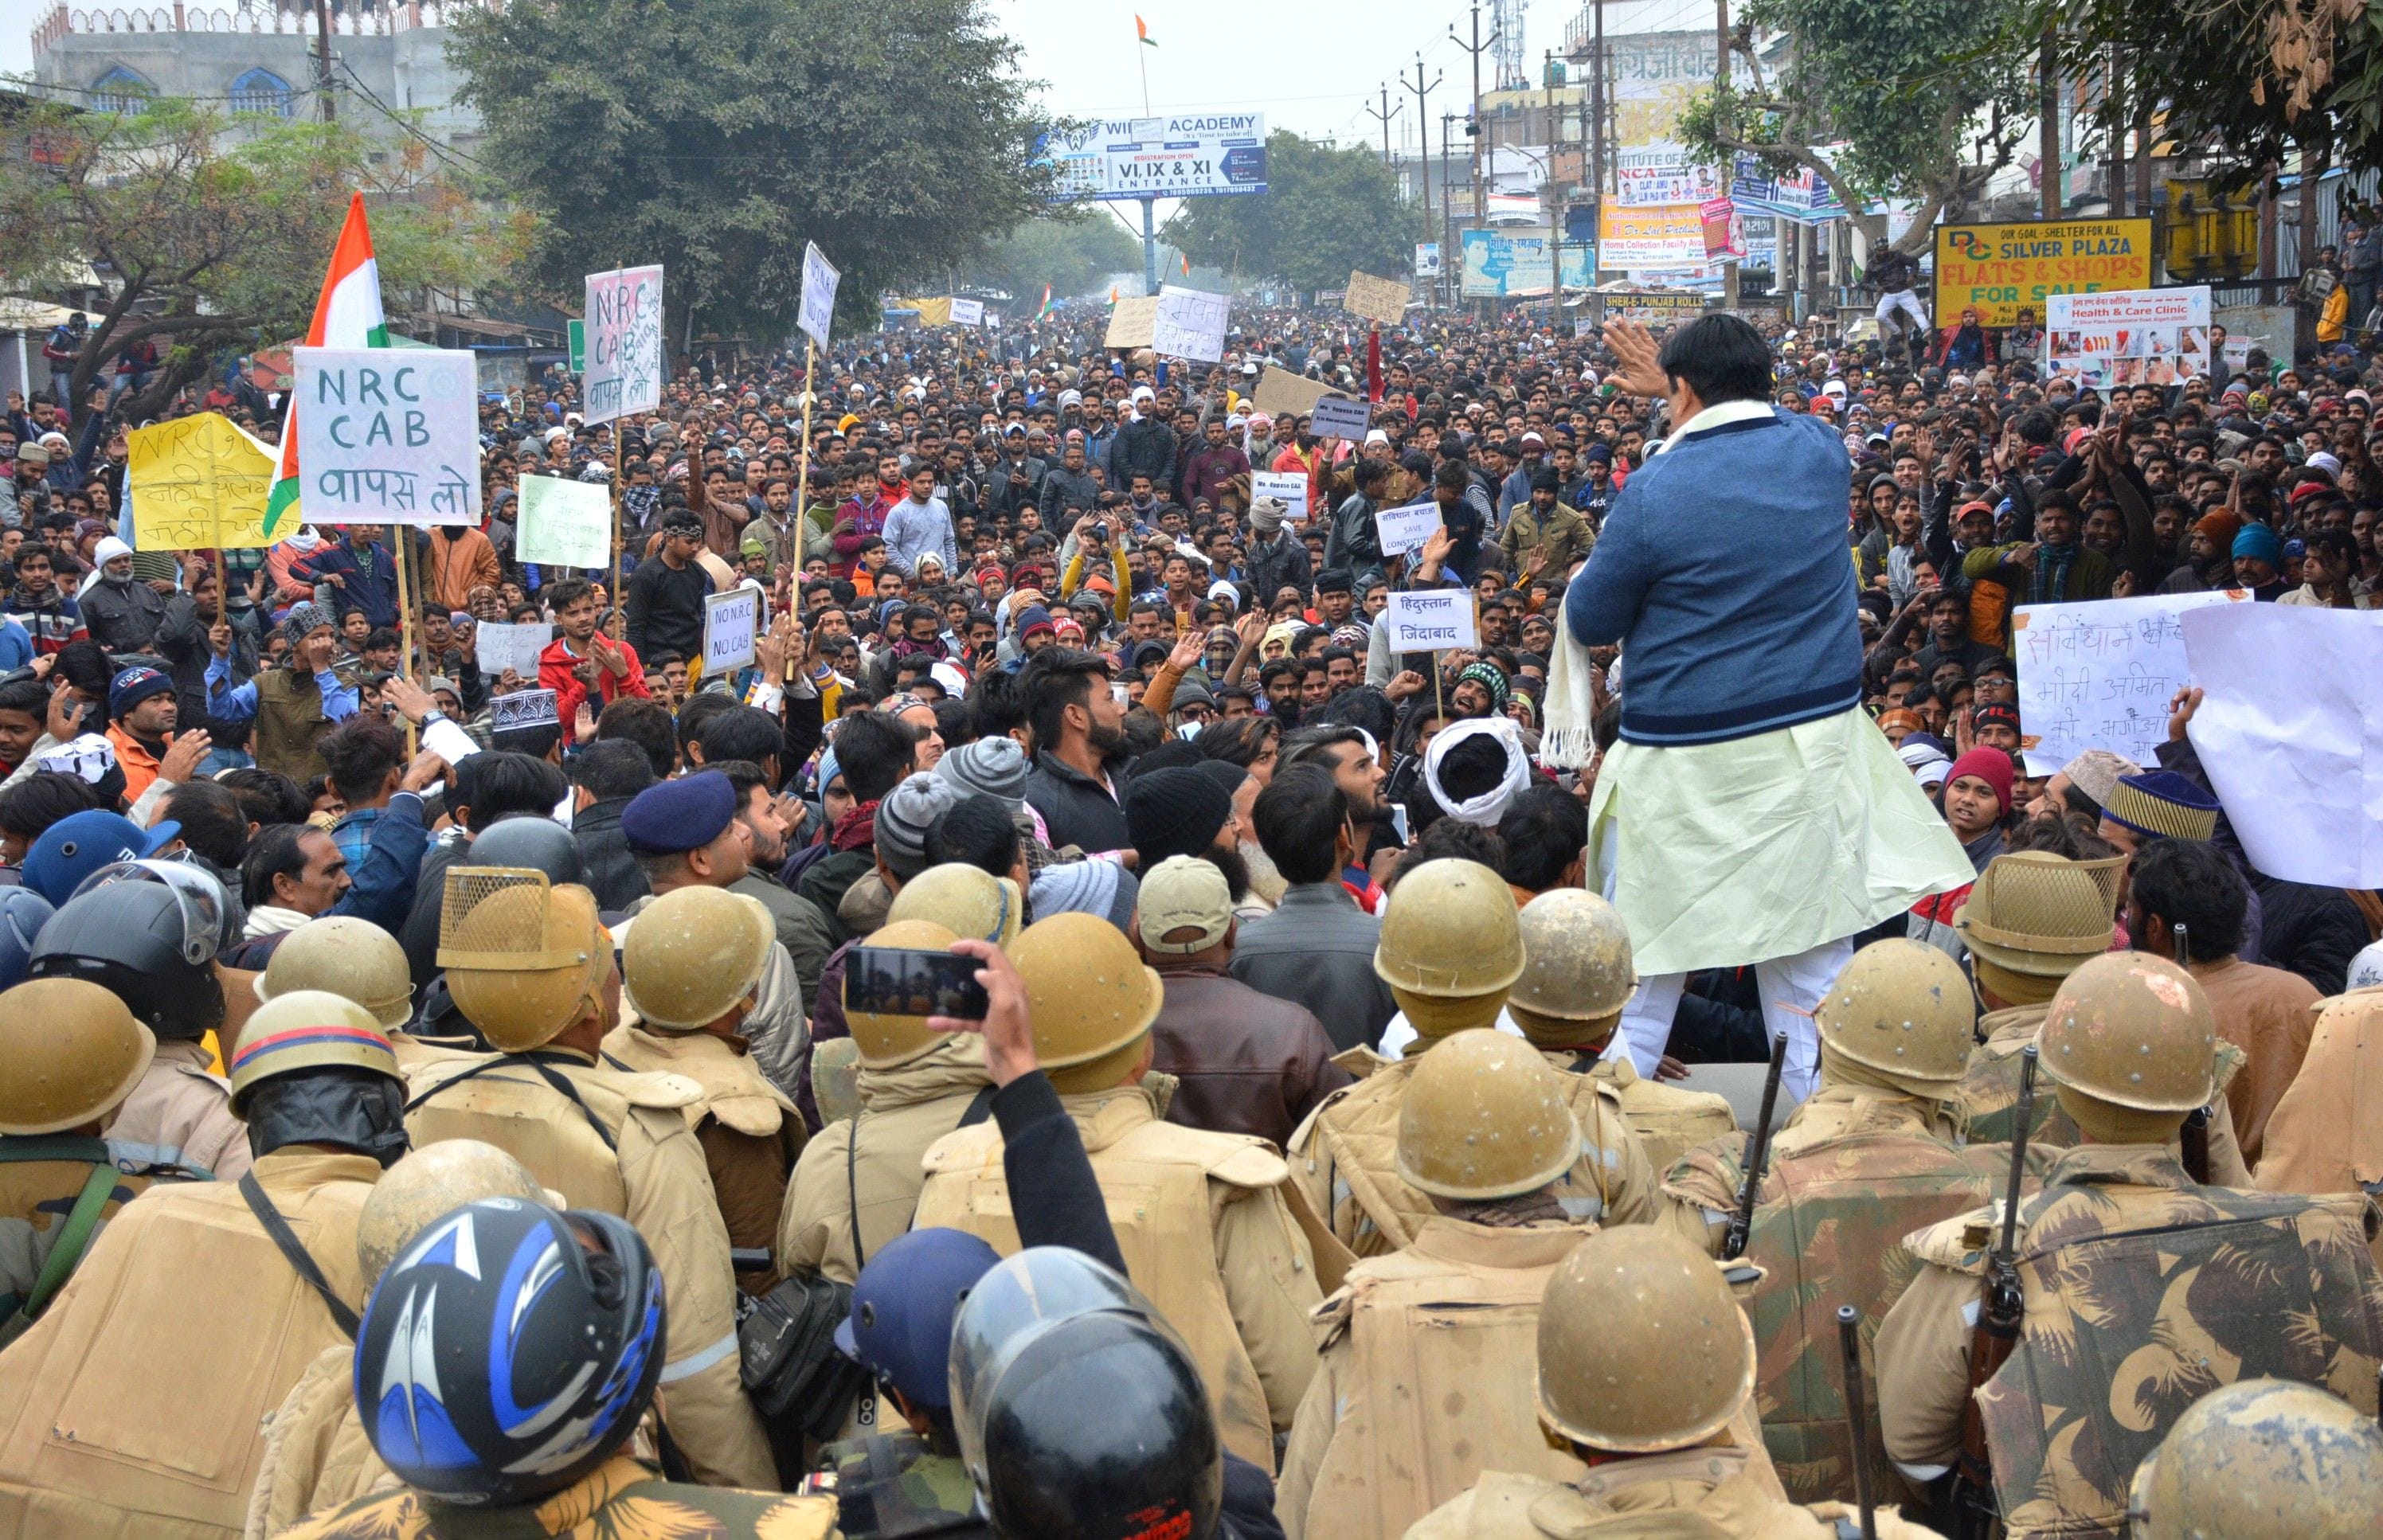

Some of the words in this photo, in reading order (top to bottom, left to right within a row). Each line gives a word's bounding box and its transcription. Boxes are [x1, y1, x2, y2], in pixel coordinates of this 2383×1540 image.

[1169, 116, 1255, 132] ACADEMY
[1119, 163, 1142, 179] VI,
[1147, 162, 1165, 177] IX
[1173, 161, 1184, 175] &
[1192, 160, 1211, 175] XI
[1618, 167, 1657, 180] NCA
[1119, 176, 1212, 188] ENTRANCE
[1665, 223, 1704, 234] PathLa
[2001, 229, 2015, 240] OUR
[2018, 228, 2038, 240] GOAL
[2045, 226, 2084, 239] SHELTER
[2086, 225, 2103, 236] FOR
[2105, 225, 2120, 236] ALL
[1604, 240, 1624, 249] Home
[1626, 240, 1660, 249] Collection
[1662, 240, 1687, 249] Facility
[2000, 241, 2063, 260] SILVER
[2072, 237, 2132, 256] PLAZA
[1941, 261, 2027, 286] FLATS
[2034, 260, 2052, 281] &
[2056, 256, 2144, 282] SHOPS
[1641, 296, 1673, 307] PUNJAB
[1970, 286, 2019, 303] FOR
[597, 283, 647, 327] NRC
[2072, 308, 2109, 318] Health
[2113, 307, 2122, 316] &
[2125, 307, 2152, 315] Care
[2155, 305, 2187, 315] Clinic
[597, 331, 636, 365] CAB
[319, 366, 421, 406] NRC
[1332, 406, 1353, 415] Oppose
[330, 409, 431, 449] CAB
[319, 468, 419, 511] वापस
[430, 464, 470, 514] लो
[1382, 510, 1411, 522] संविधान
[1403, 524, 1423, 534] SAVE
[1400, 595, 1454, 614] हिंदुस्तान
[714, 608, 729, 625] NO
[1399, 623, 1458, 640] जिंदाबाद
[713, 638, 730, 657] NO
[731, 633, 749, 652] CAB
